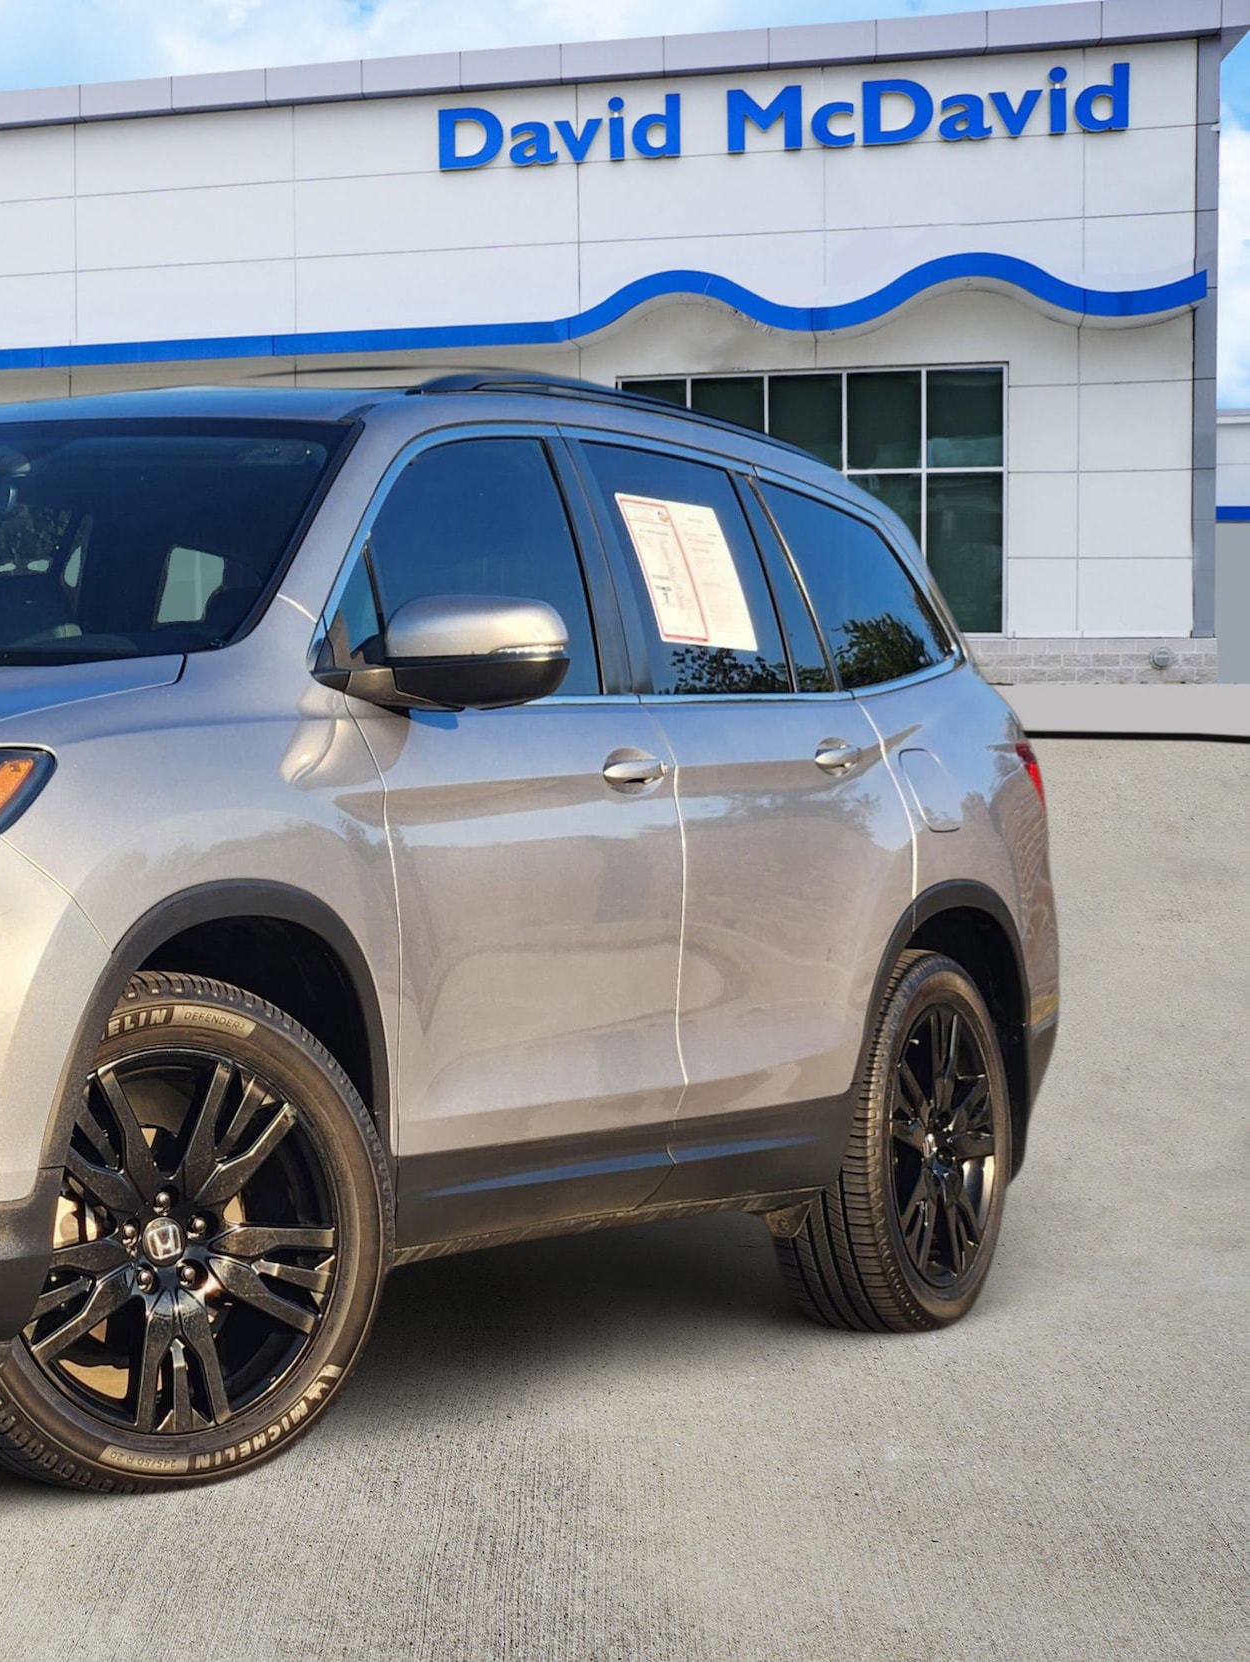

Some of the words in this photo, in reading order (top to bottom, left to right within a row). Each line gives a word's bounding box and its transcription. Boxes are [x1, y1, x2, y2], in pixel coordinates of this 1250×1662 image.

[437, 92, 682, 172] David
[727, 62, 1132, 154] McDavid
[194, 1400, 310, 1470] MICHELIN
[126, 1456, 136, 1466] R
[137, 1456, 177, 1469] 245/50
